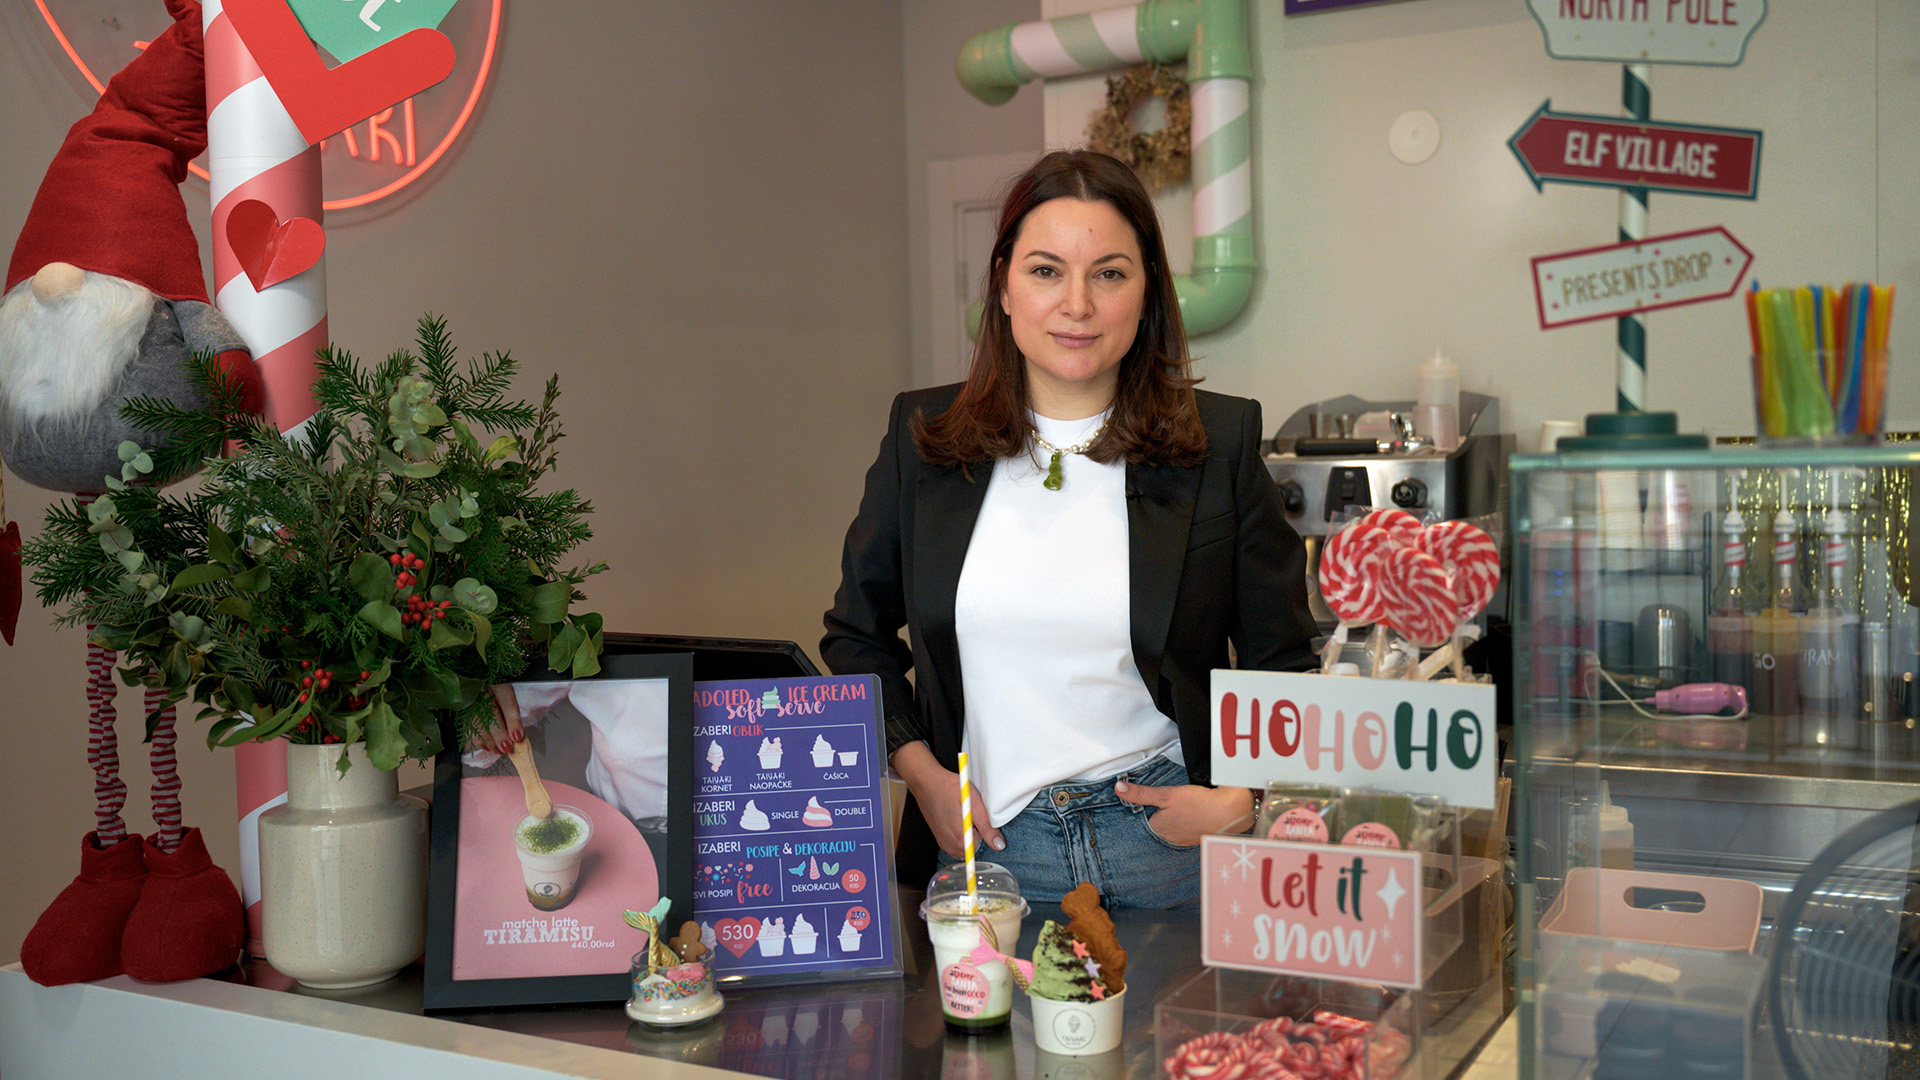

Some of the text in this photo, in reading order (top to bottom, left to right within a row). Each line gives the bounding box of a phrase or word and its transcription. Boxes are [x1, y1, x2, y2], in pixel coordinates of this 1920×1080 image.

[1563, 130, 1719, 179] ELF VILLAGE
[1561, 252, 1712, 305] PRESENTS DROP
[788, 686, 808, 702] ICE
[813, 683, 866, 702] CREAM
[726, 698, 826, 724] soft serve
[733, 724, 764, 737] OBLIK
[701, 783, 733, 793] KORNET
[749, 780, 792, 790] NAOPAČKE
[693, 801, 735, 814] IZABERI
[834, 806, 866, 816] DOUBLE
[700, 812, 727, 826] UKUS
[771, 810, 799, 820] SINGLE
[698, 840, 856, 859] IZABERI POSIPE & DEKORACIJU
[848, 873, 859, 882] 50
[693, 880, 773, 904] SVI POSIPI free
[792, 882, 840, 893] DEKORACIJA
[1336, 857, 1368, 922] it
[502, 916, 578, 929] matcha latte
[483, 926, 595, 945] TIRAMISU
[722, 923, 754, 941] 530
[571, 940, 615, 950] 440,00rsd
